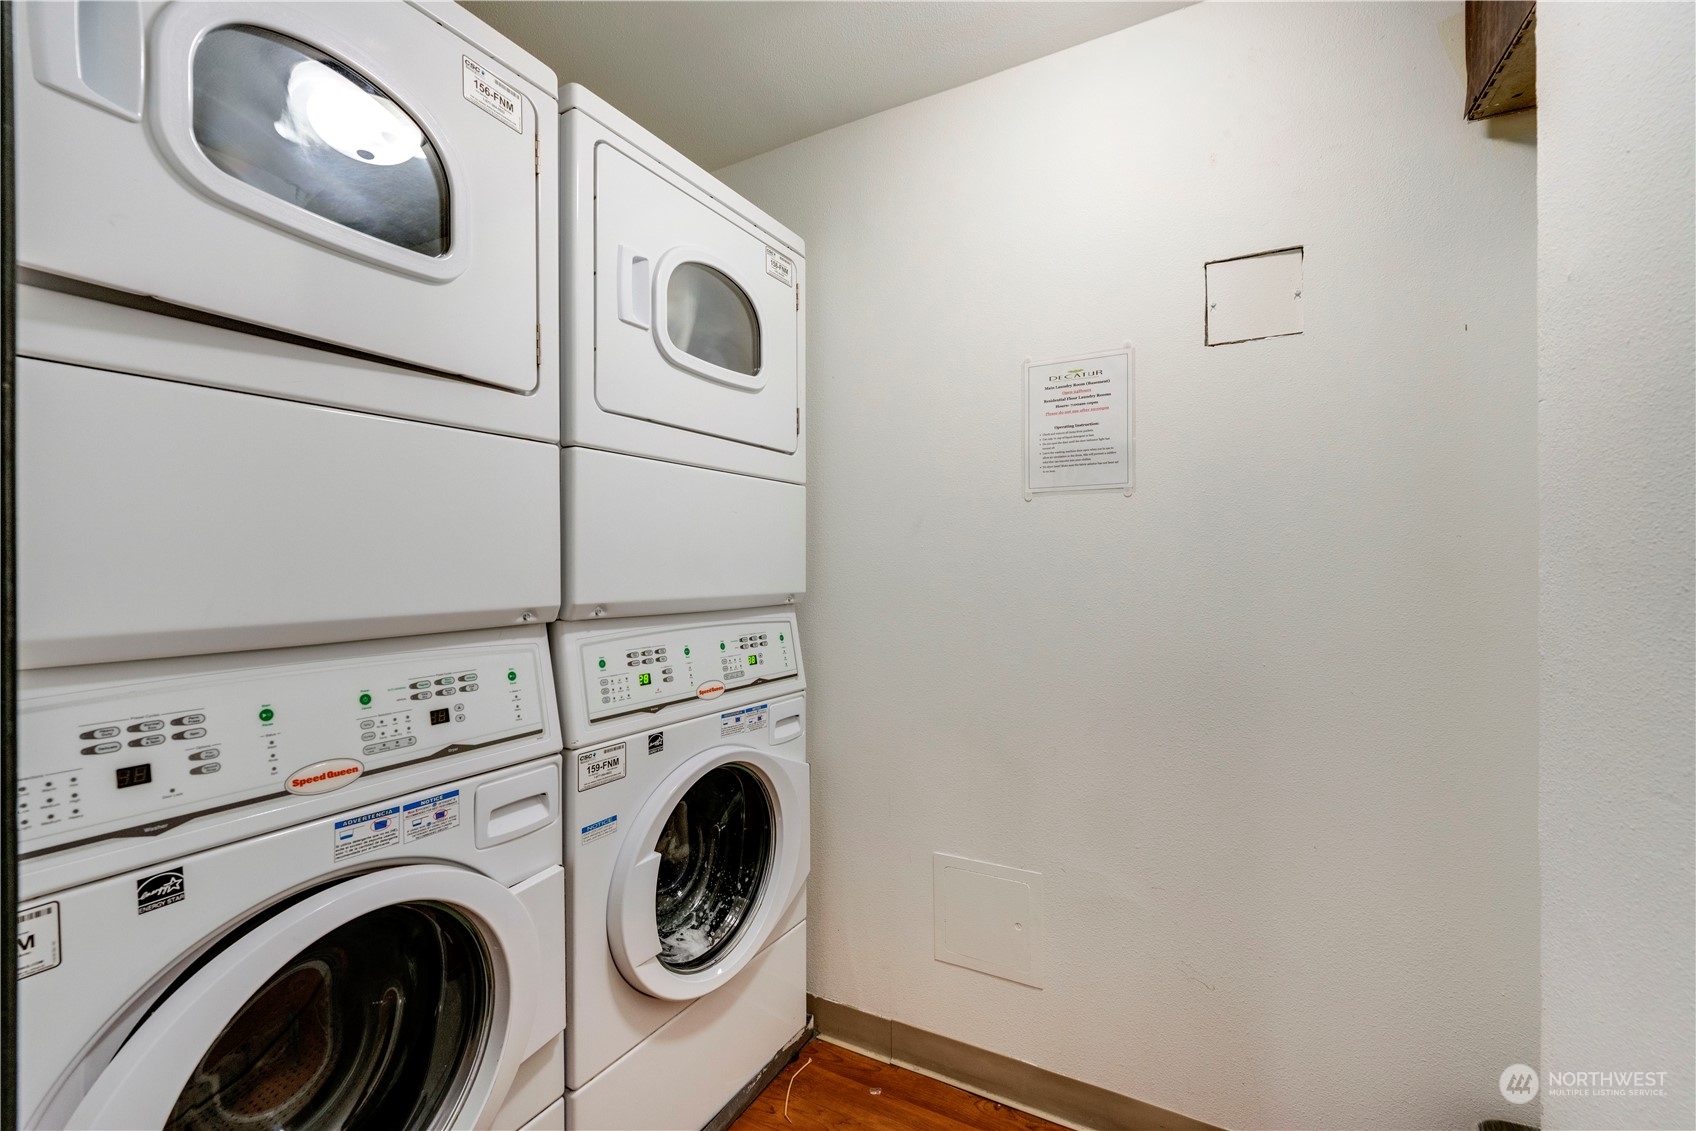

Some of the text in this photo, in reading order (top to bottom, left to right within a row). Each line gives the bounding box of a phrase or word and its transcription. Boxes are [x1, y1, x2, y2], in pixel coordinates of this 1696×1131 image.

[464, 59, 481, 73] CSC
[473, 80, 514, 112] 156-FNM
[1049, 370, 1102, 381] DECATUR
[699, 687, 712, 695] Speed
[580, 754, 593, 762] CSC
[587, 758, 620, 775] 159-FNM
[292, 766, 359, 788] Speed Queen
[421, 795, 445, 806] NOTICE
[342, 808, 393, 827] ADVERTENCIA
[586, 817, 612, 832] NOTICE
[138, 894, 185, 914] ENERGY STAR
